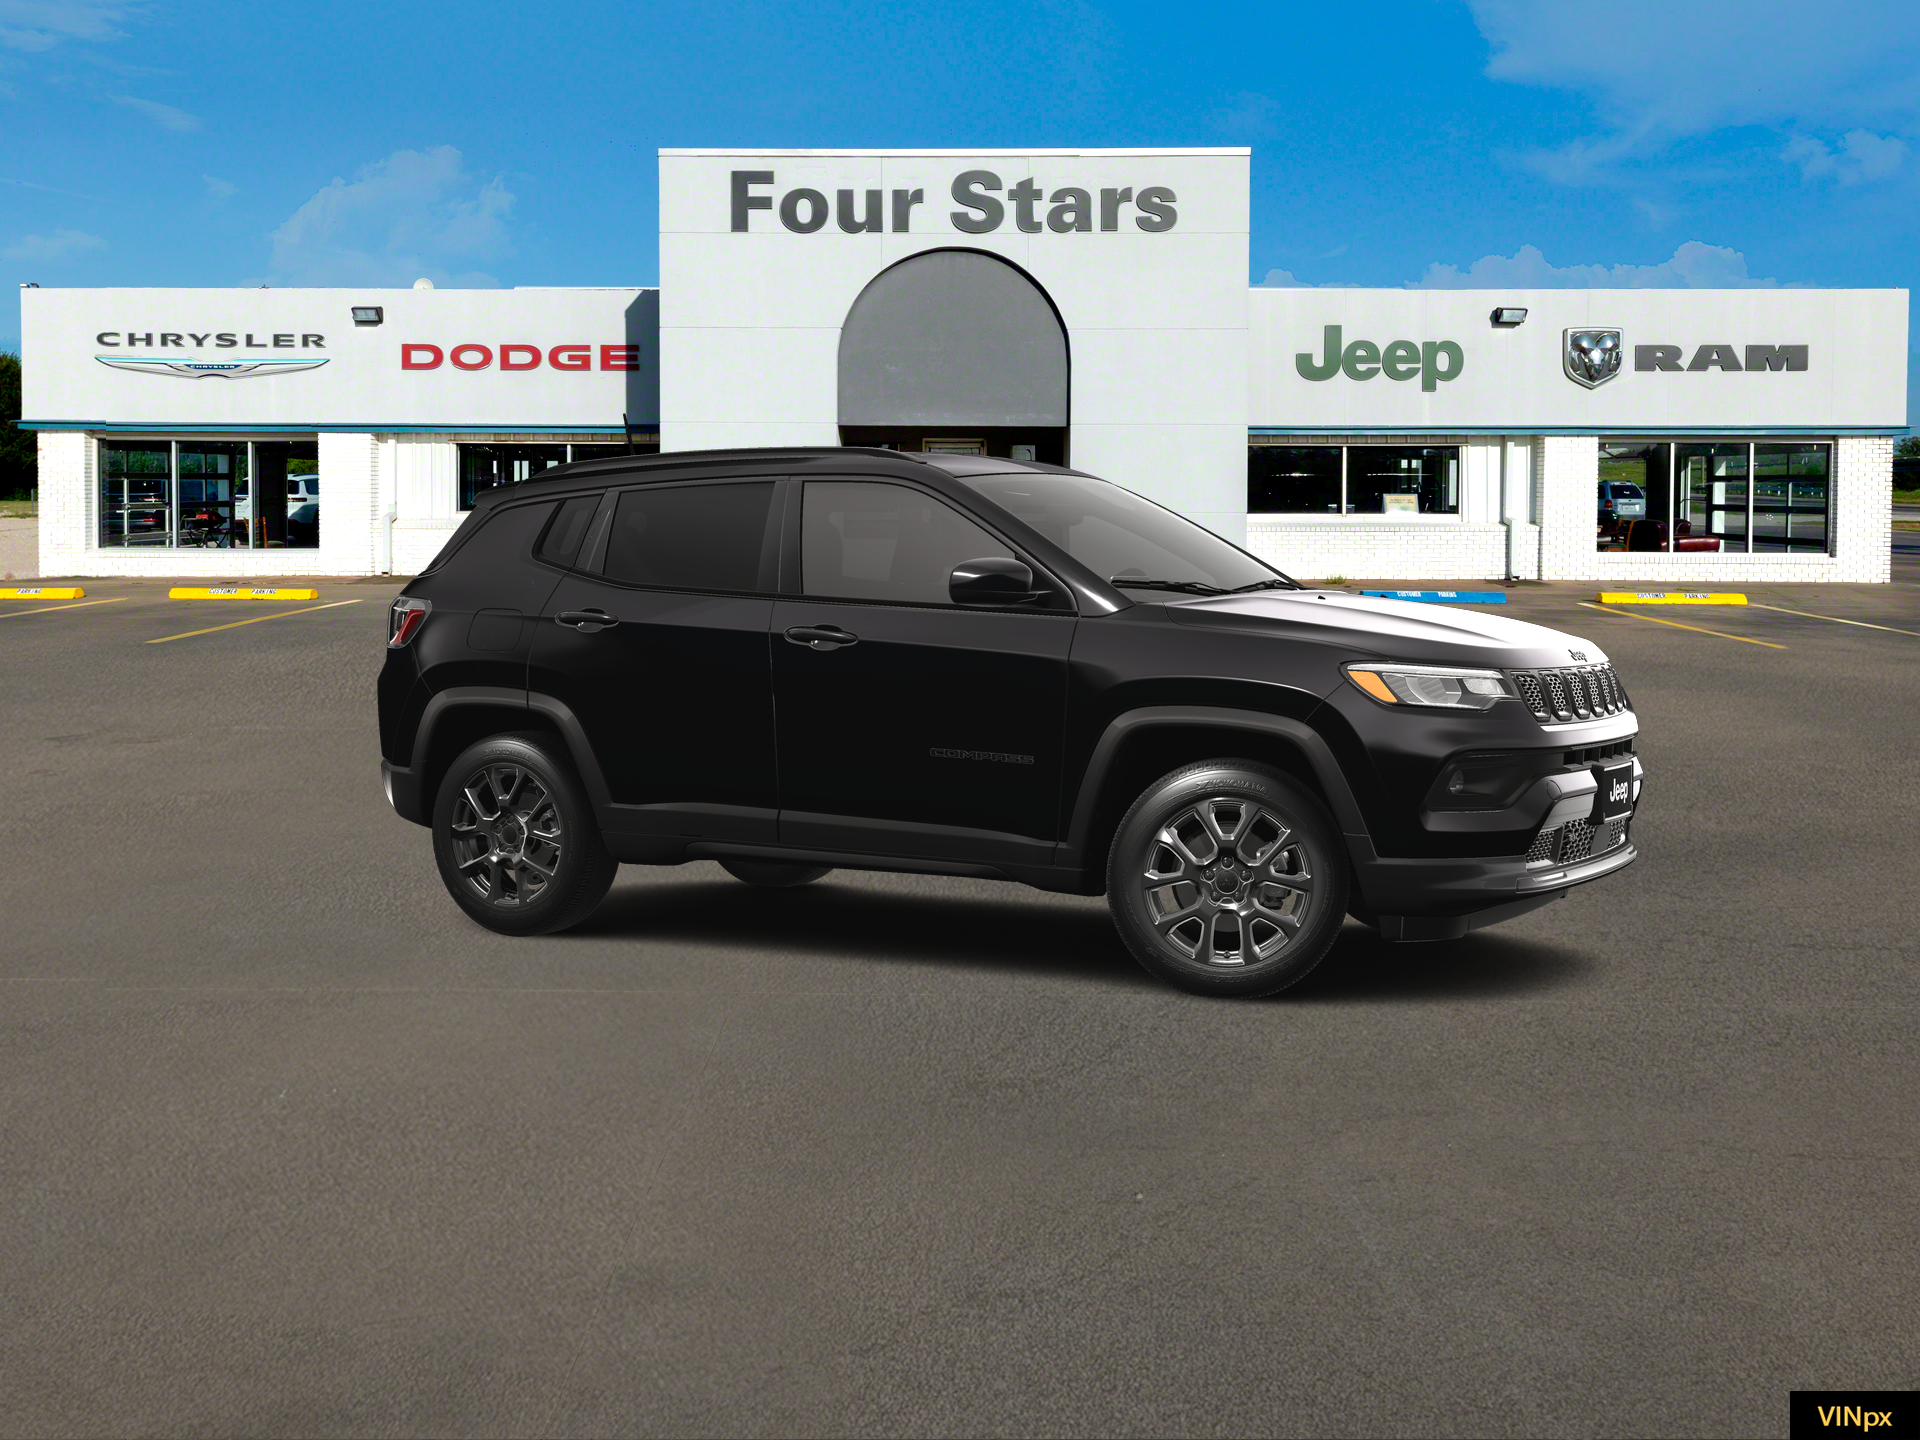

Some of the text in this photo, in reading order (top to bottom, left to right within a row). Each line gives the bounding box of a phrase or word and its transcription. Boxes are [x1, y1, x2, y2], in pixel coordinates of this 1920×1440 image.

[730, 169, 1178, 233] Four Stars
[96, 331, 326, 348] CHRYSLER
[401, 343, 640, 371] DODGE
[1295, 324, 1464, 392] Jeep
[1634, 344, 1808, 372] RAM
[1396, 590, 1458, 598] CUSTOMER PARKING
[1568, 649, 1588, 663] Jeep
[930, 747, 1035, 765] COMPASS
[1609, 778, 1629, 804] Jeep
